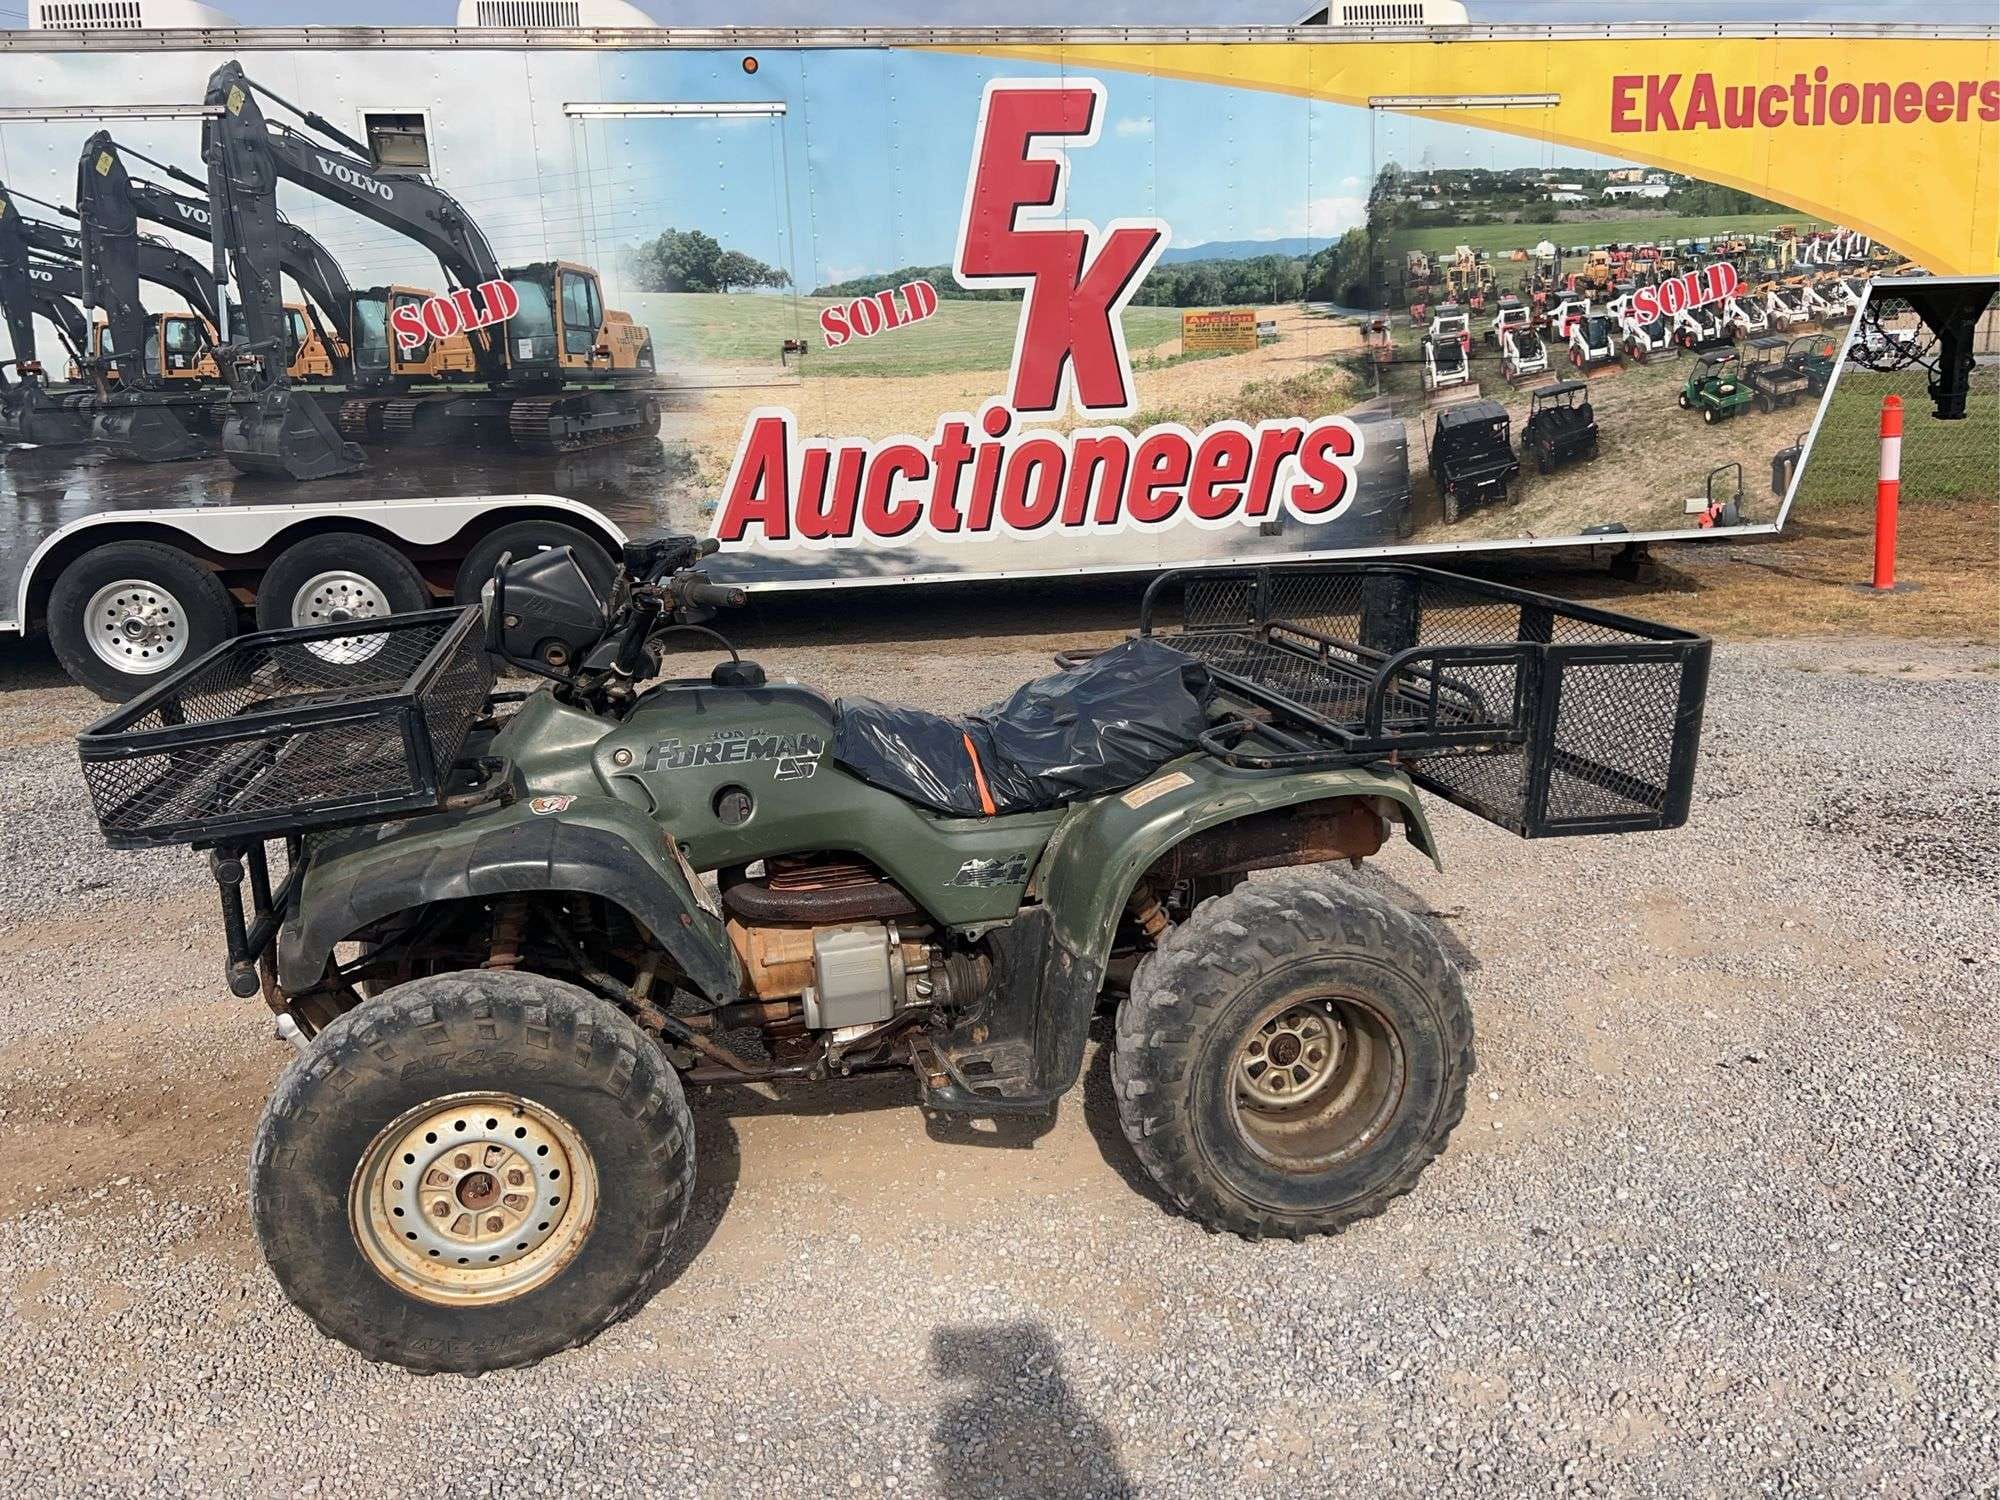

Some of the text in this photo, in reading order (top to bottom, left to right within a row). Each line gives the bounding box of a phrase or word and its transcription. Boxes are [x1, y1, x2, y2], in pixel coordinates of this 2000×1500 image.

[1611, 66, 2000, 132] EKAuctioneers
[315, 155, 394, 201] VOLVO
[961, 88, 1160, 409] EK
[391, 280, 519, 350] SOLD
[820, 280, 939, 348] SOLD
[1189, 315, 1252, 324] Auction
[1632, 261, 1737, 326] SOLD
[718, 405, 1355, 542] Auctioneers
[642, 733, 825, 773] FOREMAN
